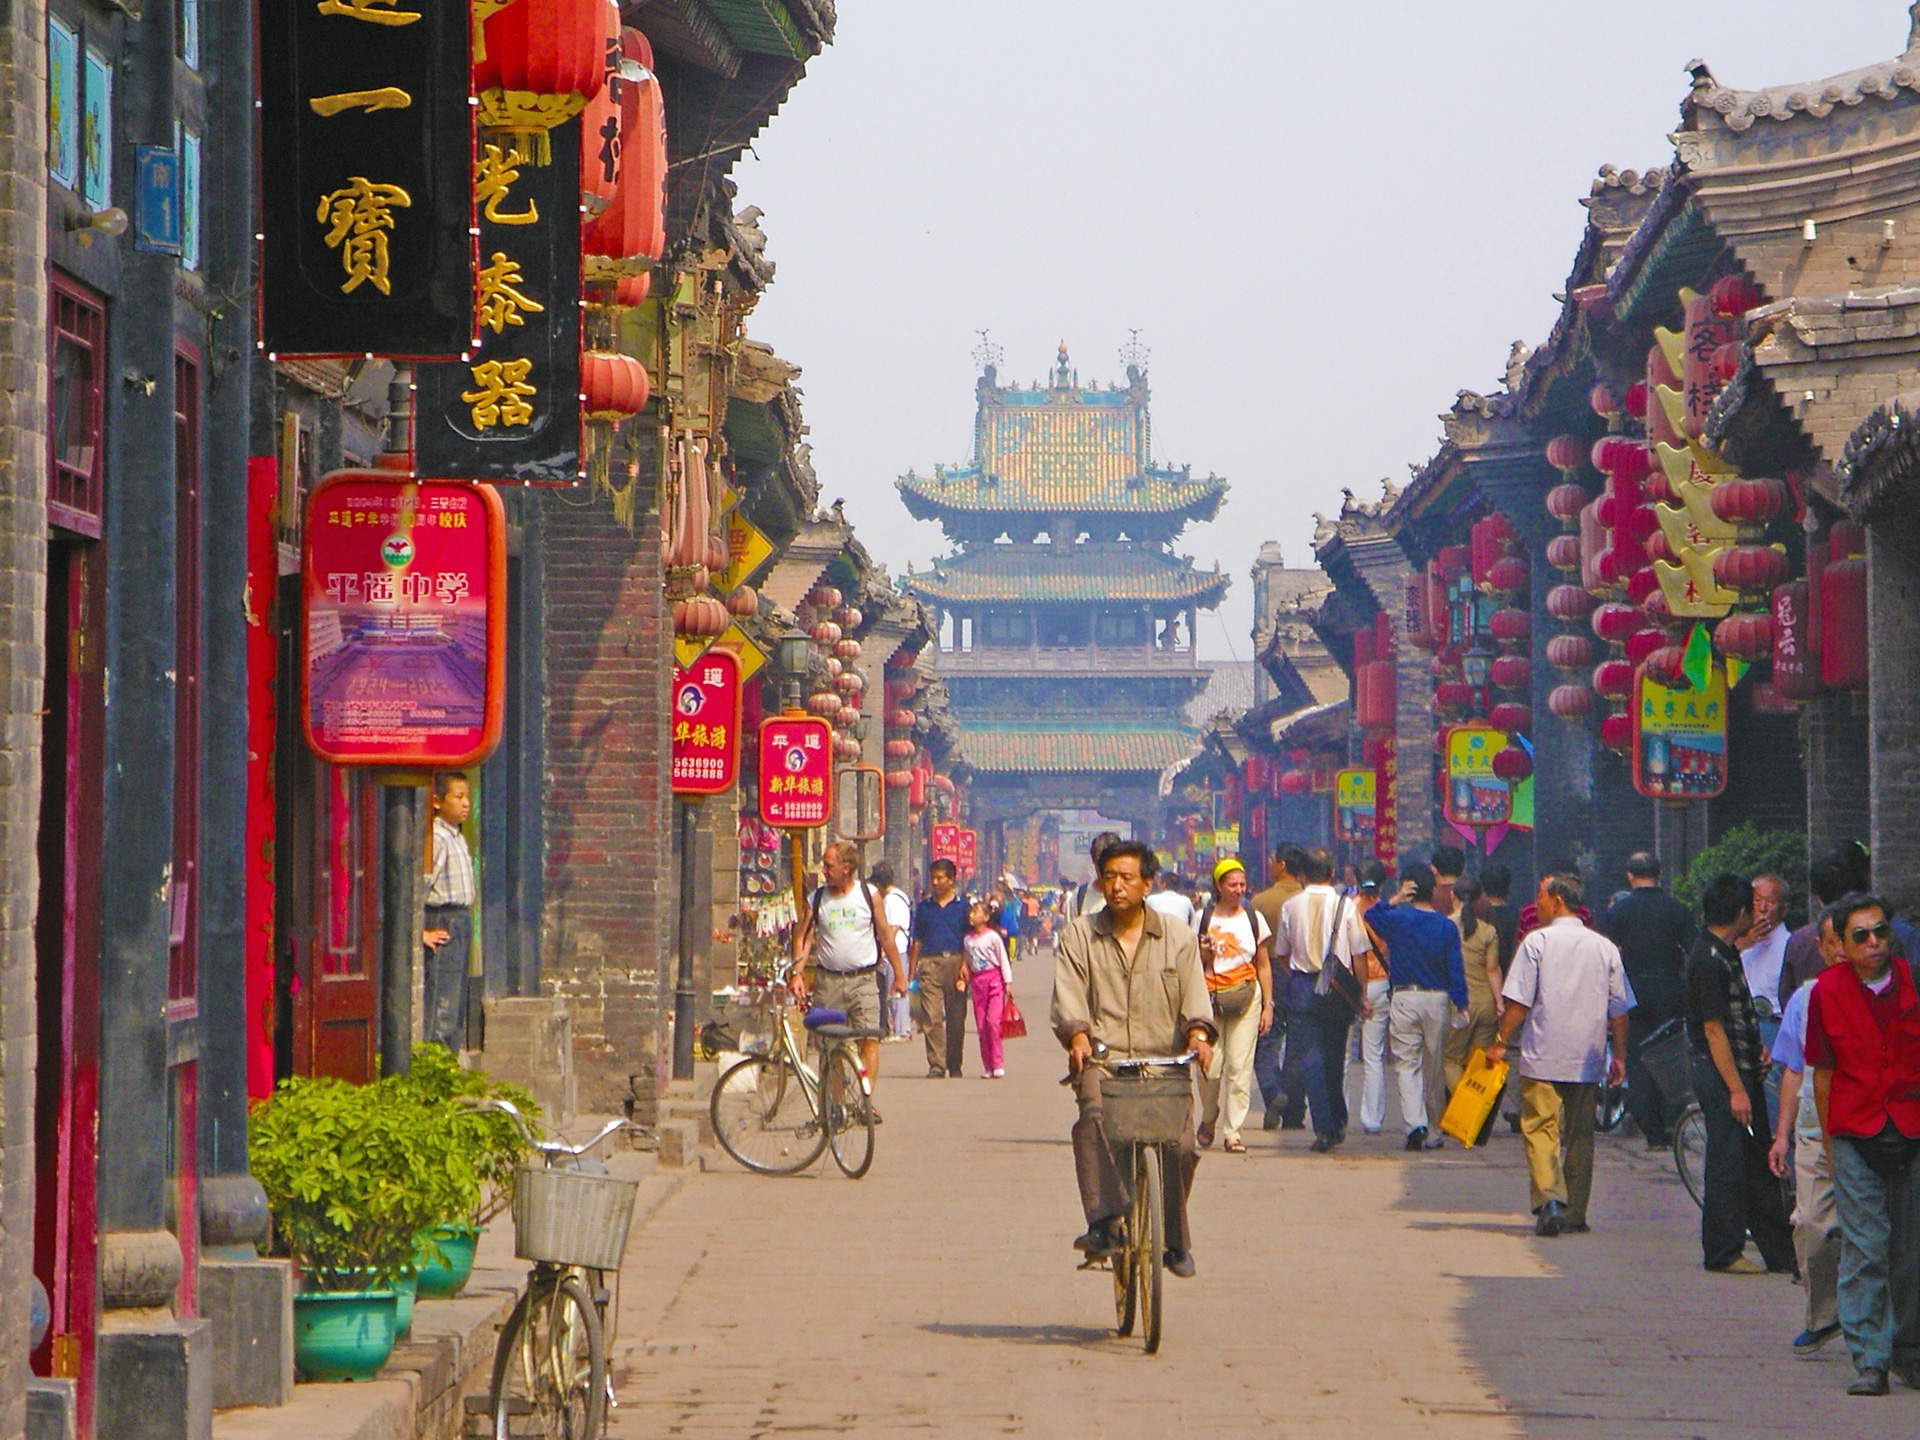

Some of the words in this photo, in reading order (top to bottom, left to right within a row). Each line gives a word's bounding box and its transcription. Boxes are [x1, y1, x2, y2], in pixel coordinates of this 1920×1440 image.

[326, 572, 469, 606] 平遥中学
[673, 768, 724, 779] 5683888
